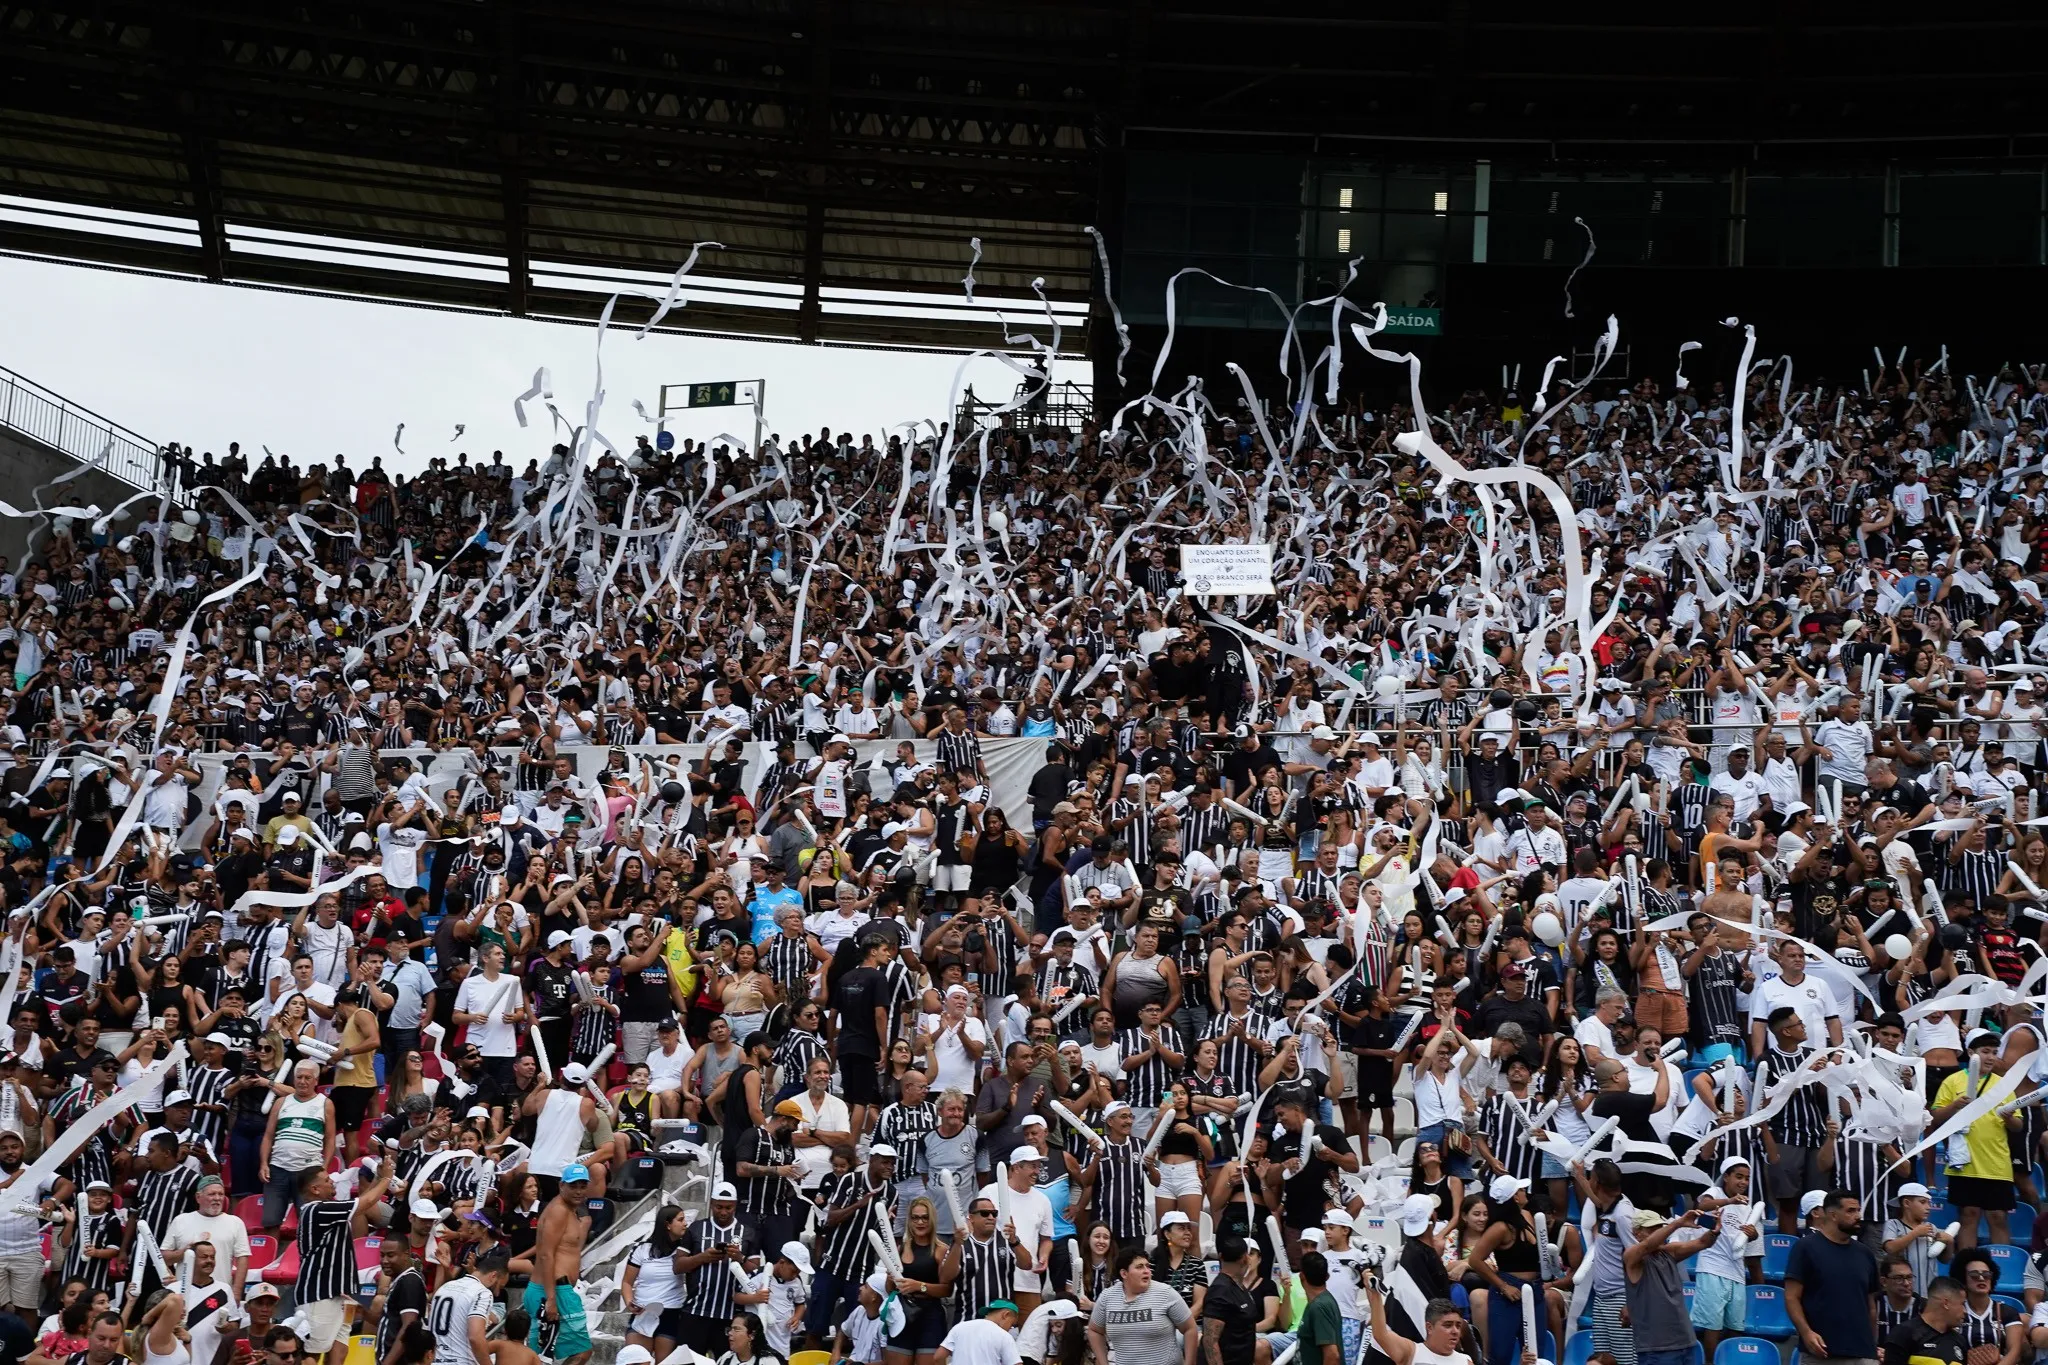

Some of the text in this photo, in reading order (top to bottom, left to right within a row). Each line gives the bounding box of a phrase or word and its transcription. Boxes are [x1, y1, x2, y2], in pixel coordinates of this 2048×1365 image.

[1388, 313, 1435, 327] SAÍDA
[1201, 557, 1234, 565] CORAÇÃO
[1683, 804, 1704, 829] 10
[640, 971, 667, 979] CONFIA
[1045, 970, 1053, 995] BANESTES
[553, 984, 566, 998] T
[1396, 1019, 1415, 1046] BANESTES
[3, 1088, 11, 1119] BANESTES
[1511, 1103, 1531, 1130] BANESTES
[477, 1171, 491, 1203] BANESTES
[82, 1215, 91, 1247] BANESTE
[877, 1218, 894, 1253] BANESTES
[1539, 1229, 1549, 1262] BANESTES
[430, 1295, 453, 1335] 10
[1108, 1309, 1151, 1323] OAKLEY
[1359, 1326, 1375, 1355] BANEST
